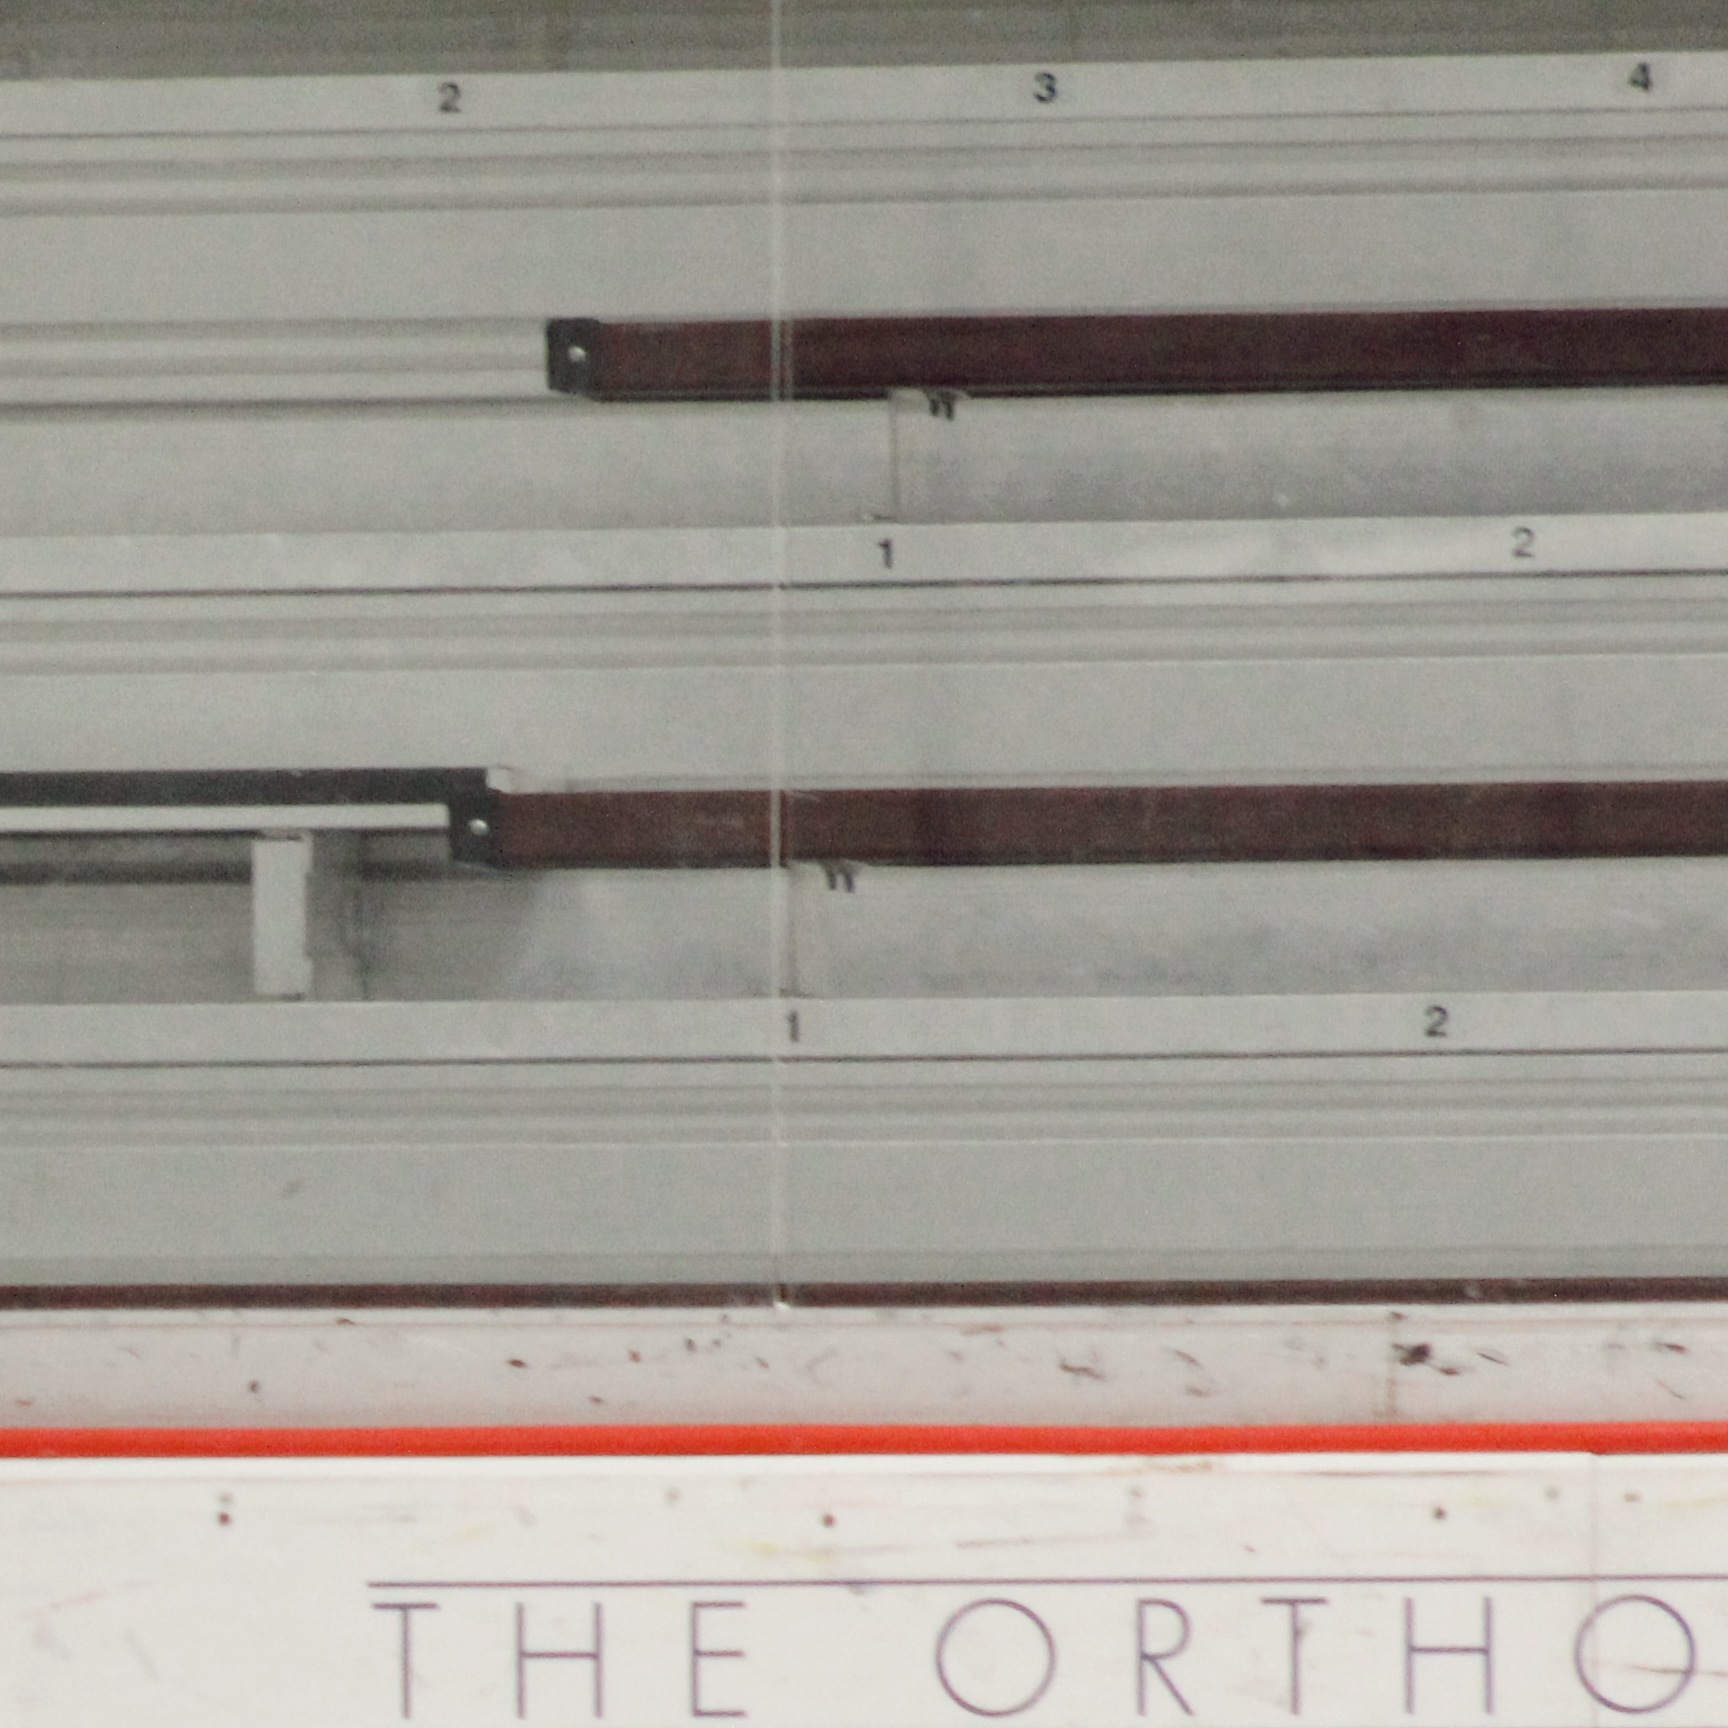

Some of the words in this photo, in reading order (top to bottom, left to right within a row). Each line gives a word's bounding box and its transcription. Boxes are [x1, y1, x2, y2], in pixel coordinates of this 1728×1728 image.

[1033, 72, 1057, 103] 3
[1629, 62, 1653, 92] 4
[439, 82, 462, 113] 2
[876, 538, 894, 569] 1
[1512, 526, 1535, 558] 2
[786, 1010, 801, 1042] 1
[1425, 1005, 1448, 1038] 2
[372, 1600, 747, 1719] THE
[935, 1593, 1697, 1719] ORTHO
